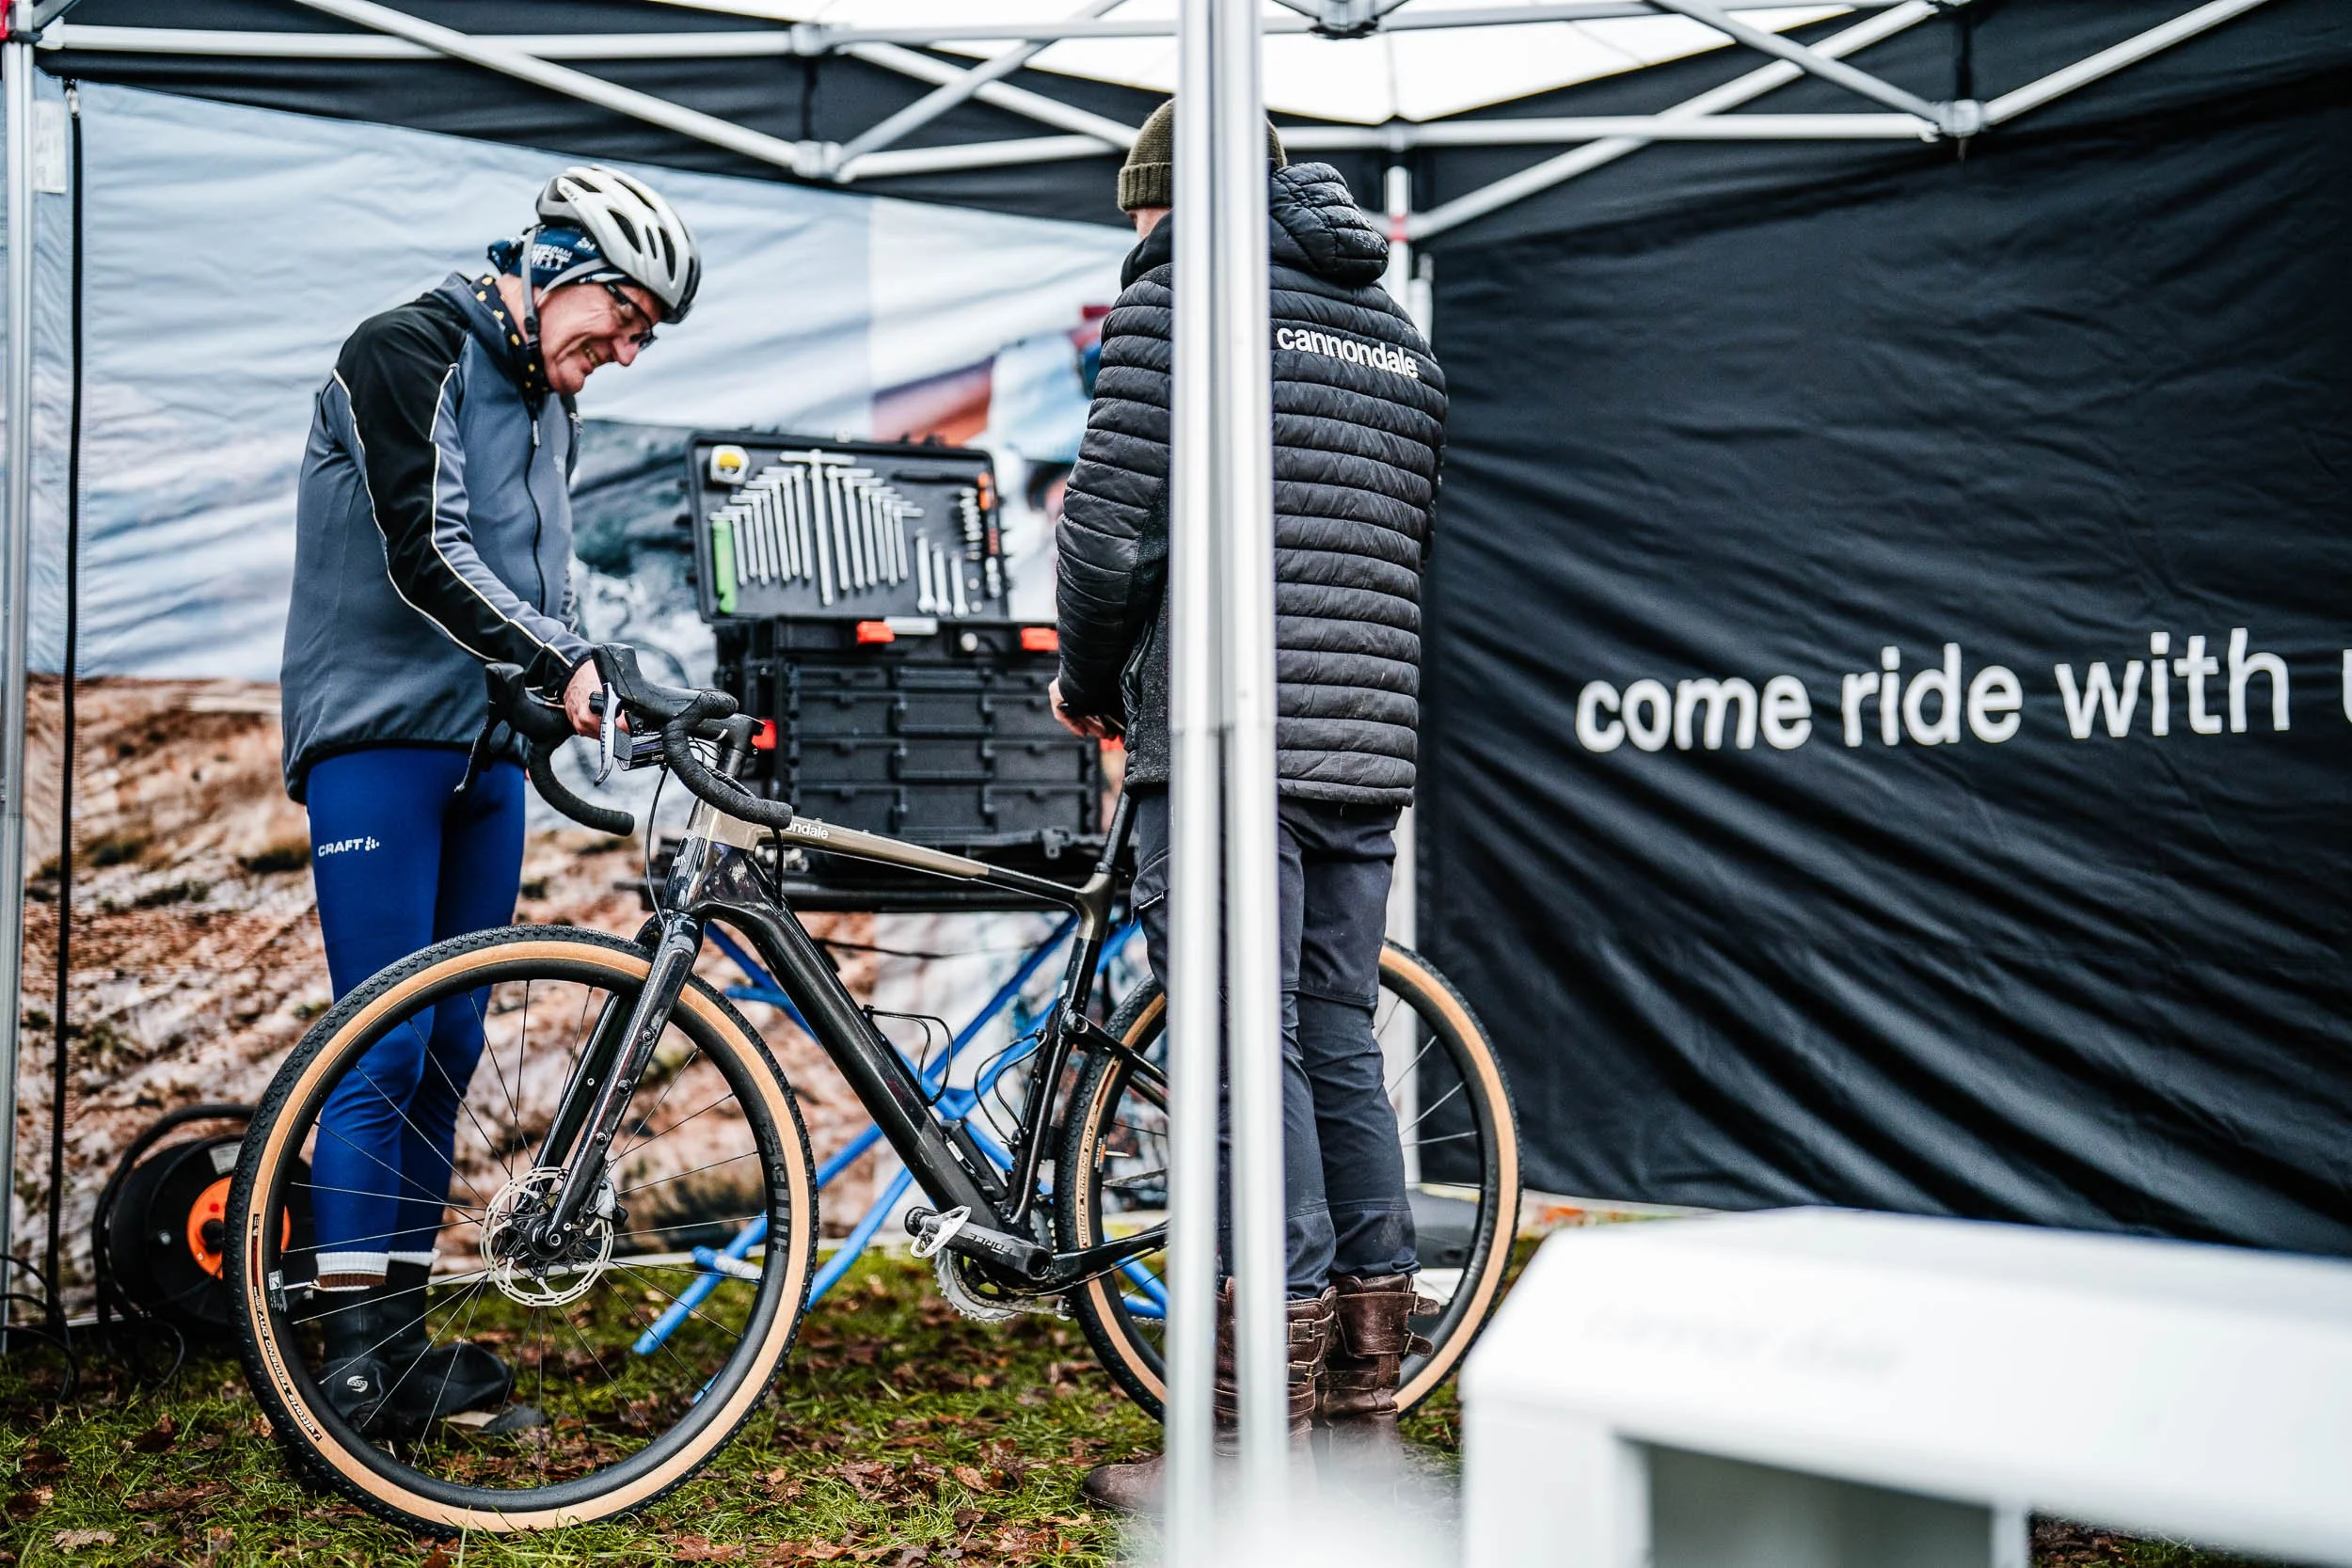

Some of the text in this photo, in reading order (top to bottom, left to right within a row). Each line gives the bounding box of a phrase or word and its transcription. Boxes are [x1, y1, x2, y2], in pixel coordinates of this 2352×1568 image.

[1277, 327, 1419, 379] cannondale
[1575, 674, 1812, 752] come
[1841, 642, 2023, 747] ride
[2054, 627, 2290, 739] with
[318, 838, 364, 857] CRAFT
[265, 1340, 289, 1391] TERRENO
